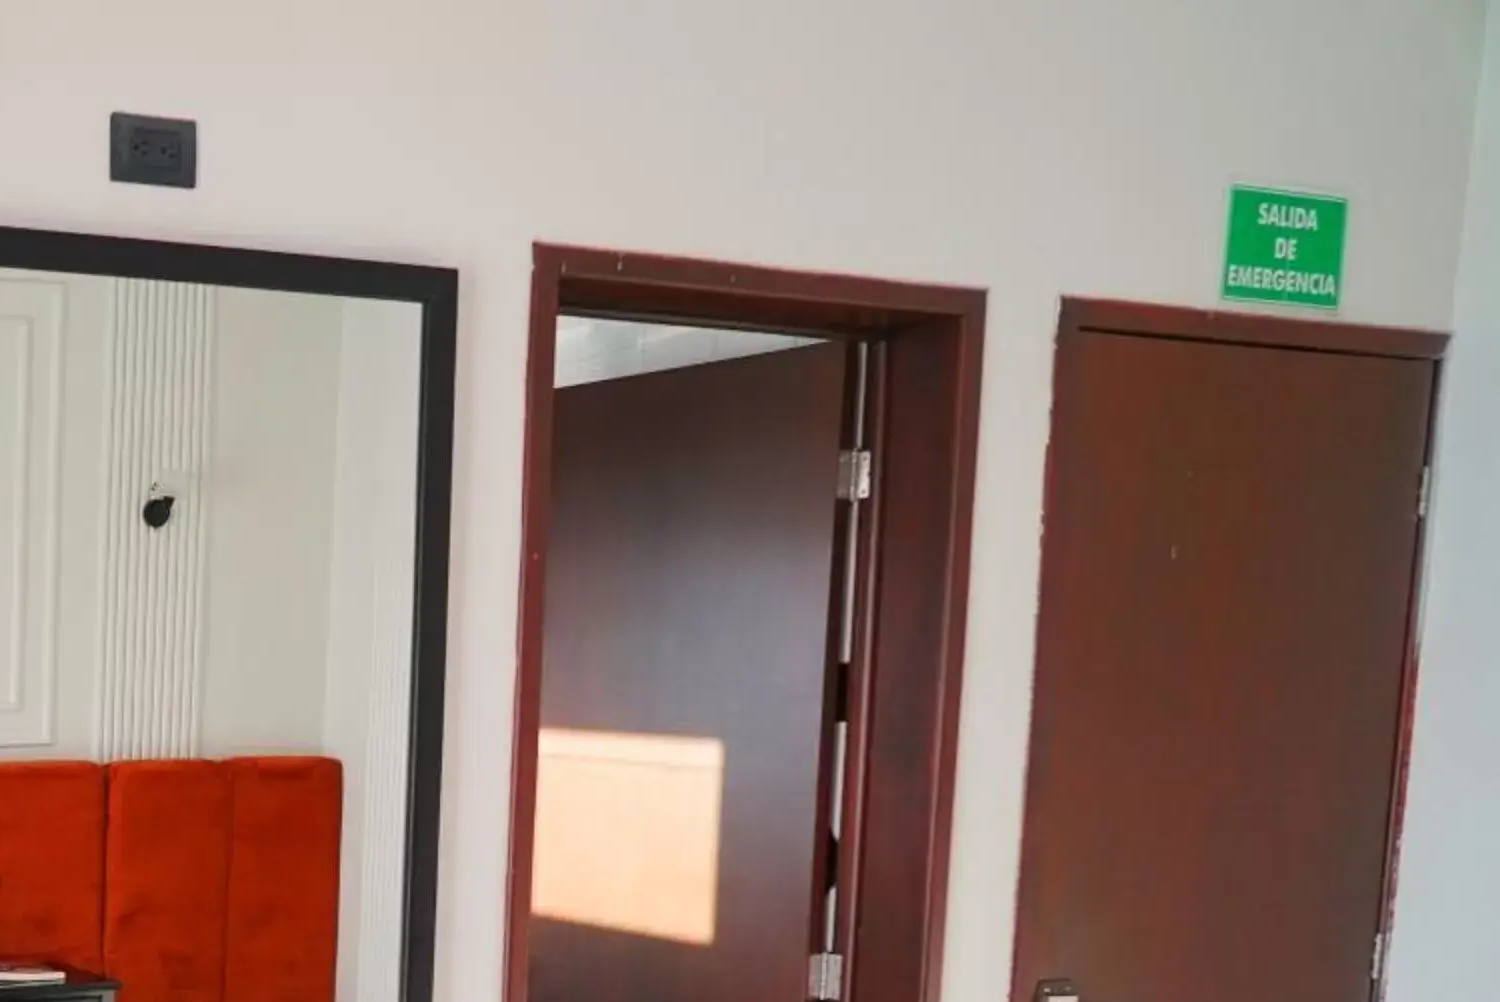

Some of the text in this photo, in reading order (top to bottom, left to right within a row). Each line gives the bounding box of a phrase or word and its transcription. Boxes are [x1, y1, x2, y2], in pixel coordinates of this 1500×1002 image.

[1257, 202, 1318, 231] SALIDA
[1273, 236, 1298, 261] DE
[1227, 264, 1336, 298] EMERGENCIA
